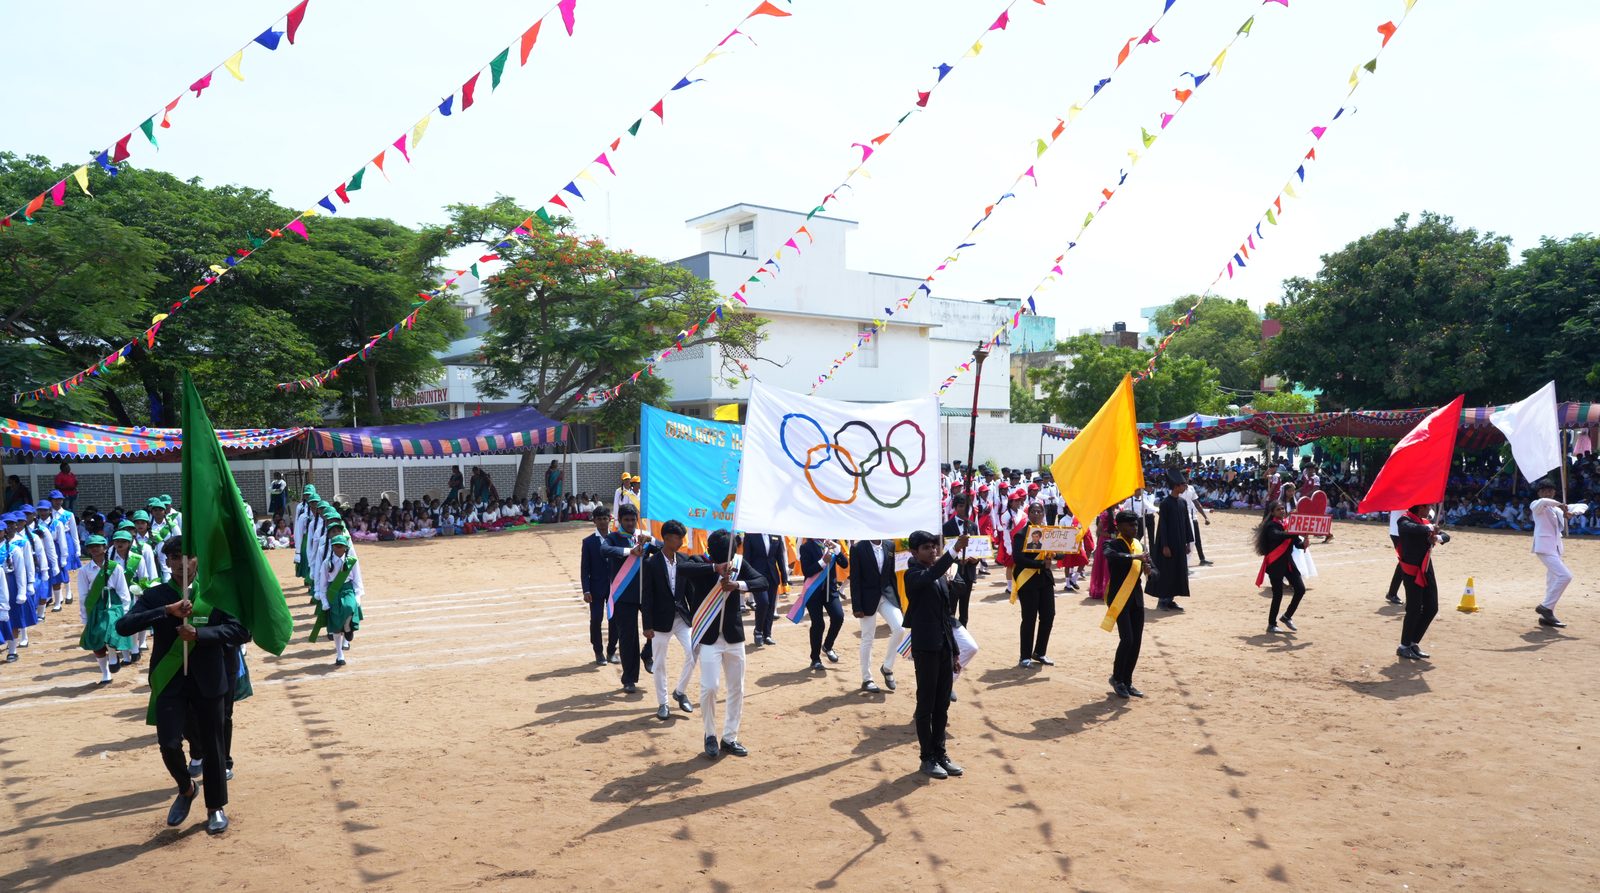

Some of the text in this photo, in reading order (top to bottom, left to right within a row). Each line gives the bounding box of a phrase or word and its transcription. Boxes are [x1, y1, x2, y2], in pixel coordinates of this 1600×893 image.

[416, 388, 448, 405] COUNTRY
[688, 508, 707, 518] LET
[1289, 515, 1332, 534] PREETHI
